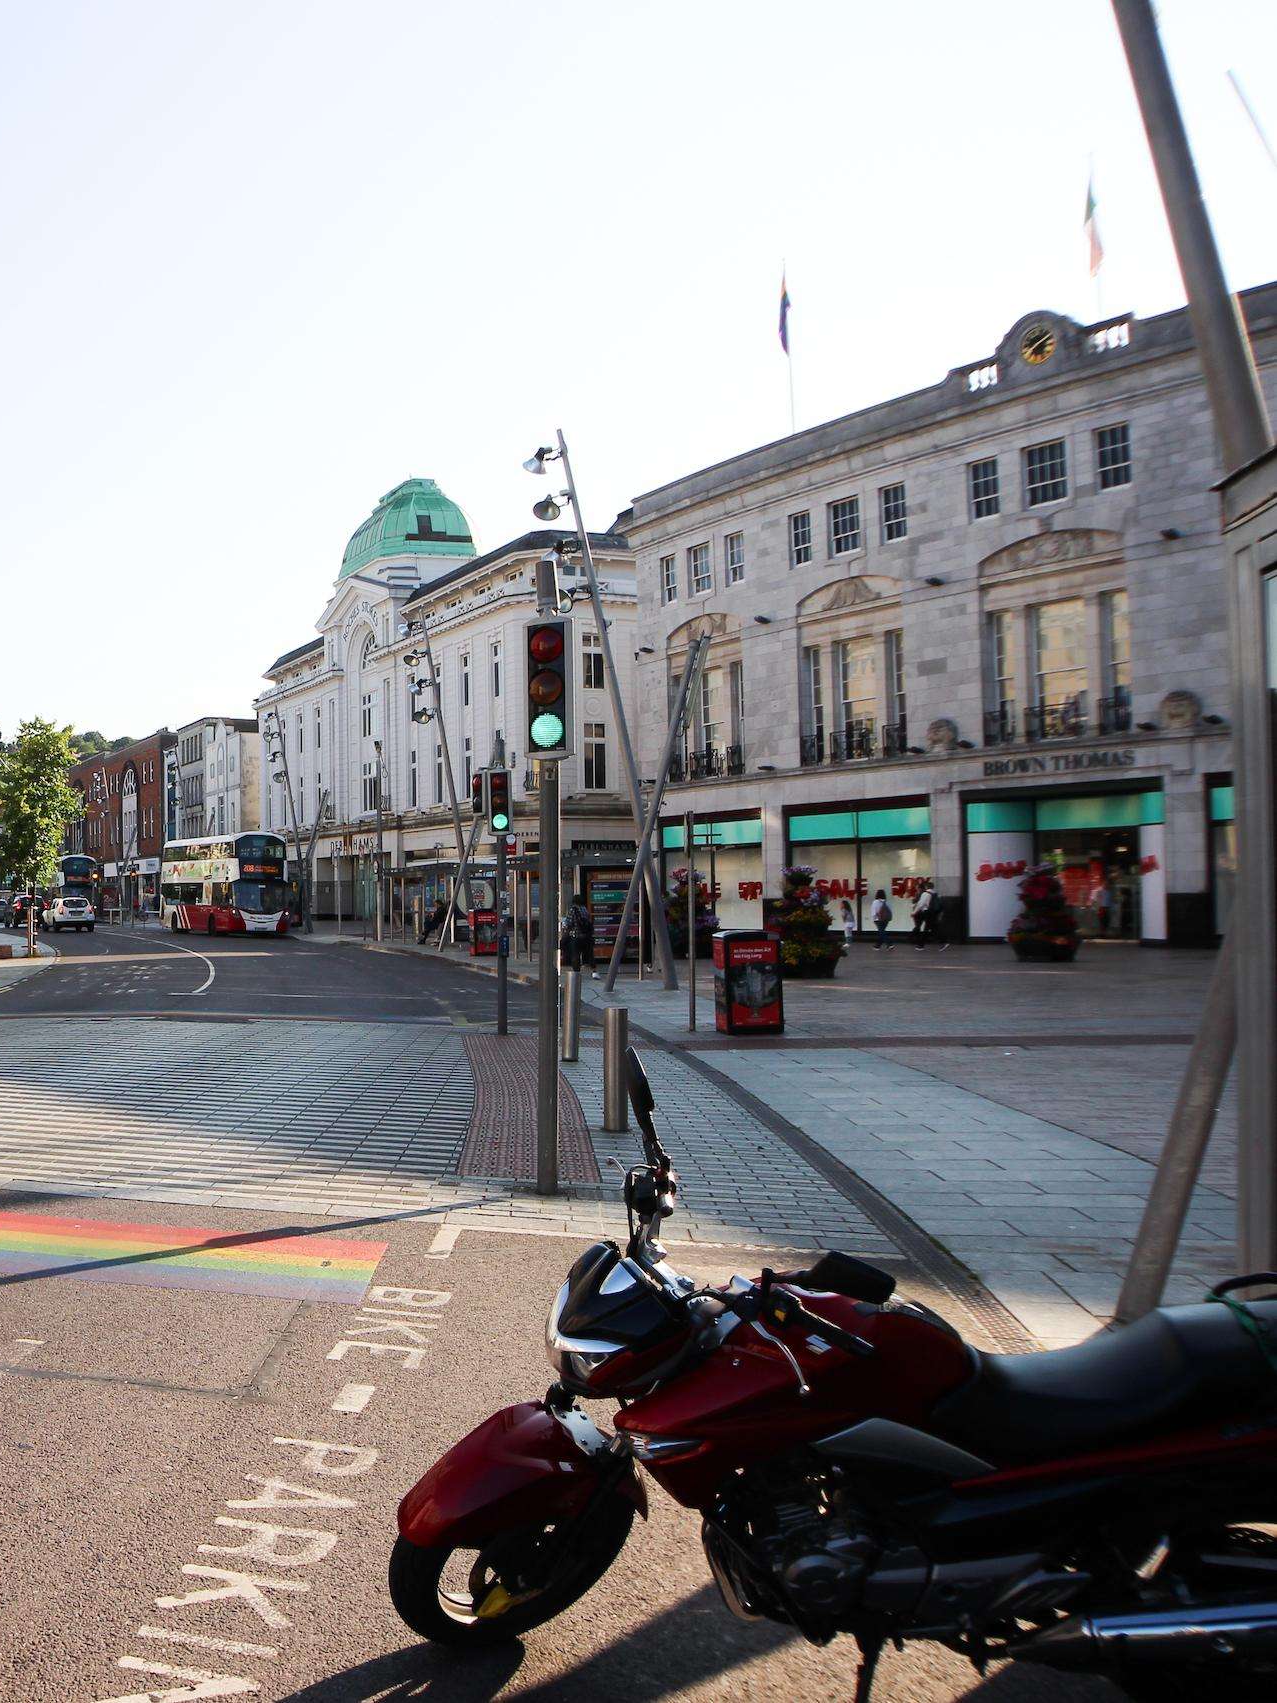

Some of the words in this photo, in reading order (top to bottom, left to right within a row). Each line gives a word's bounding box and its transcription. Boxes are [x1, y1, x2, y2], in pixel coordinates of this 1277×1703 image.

[983, 757, 1047, 776] BROWN
[1051, 750, 1134, 771] THOMAS
[326, 1285, 452, 1370] BIKE
